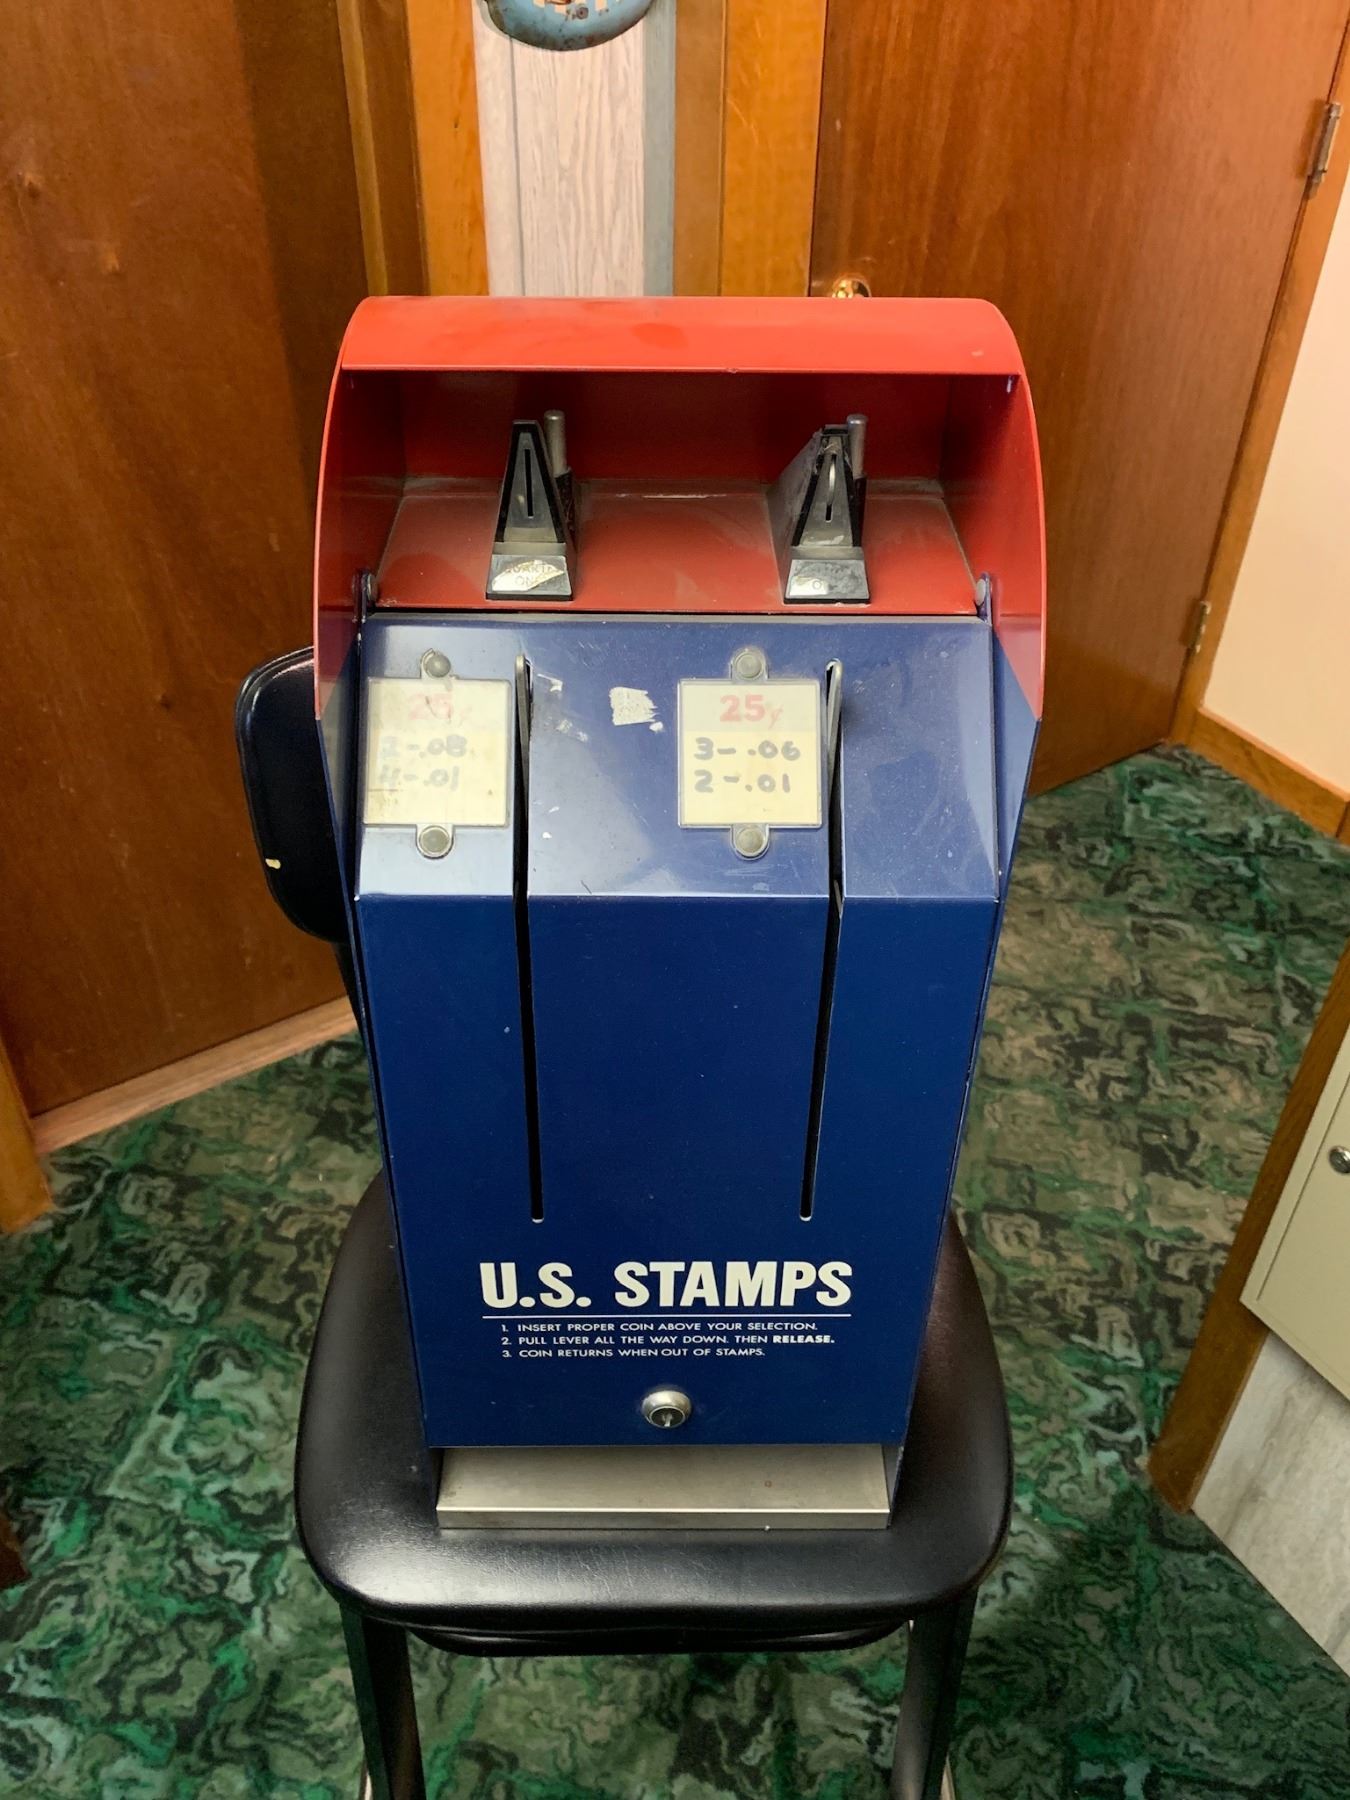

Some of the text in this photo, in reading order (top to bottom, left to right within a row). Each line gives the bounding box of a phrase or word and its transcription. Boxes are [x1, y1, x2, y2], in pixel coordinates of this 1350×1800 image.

[479, 1261, 853, 1309] U.S. STAMPS
[501, 1322, 818, 1332] 1. INSERT PROPER COIN ABOVE YOUR SELECTION.
[500, 1336, 512, 1346] 2.
[518, 1336, 547, 1346] PULL
[552, 1336, 590, 1345] LEVER
[594, 1336, 615, 1345] ALL
[620, 1335, 645, 1345] THE
[649, 1335, 678, 1344] WAY
[734, 1335, 768, 1344] THEN
[772, 1334, 835, 1344] RELEASE.
[502, 1347, 766, 1358] 3. COIN RETURNS WHEN OUT OF STAMPS.
